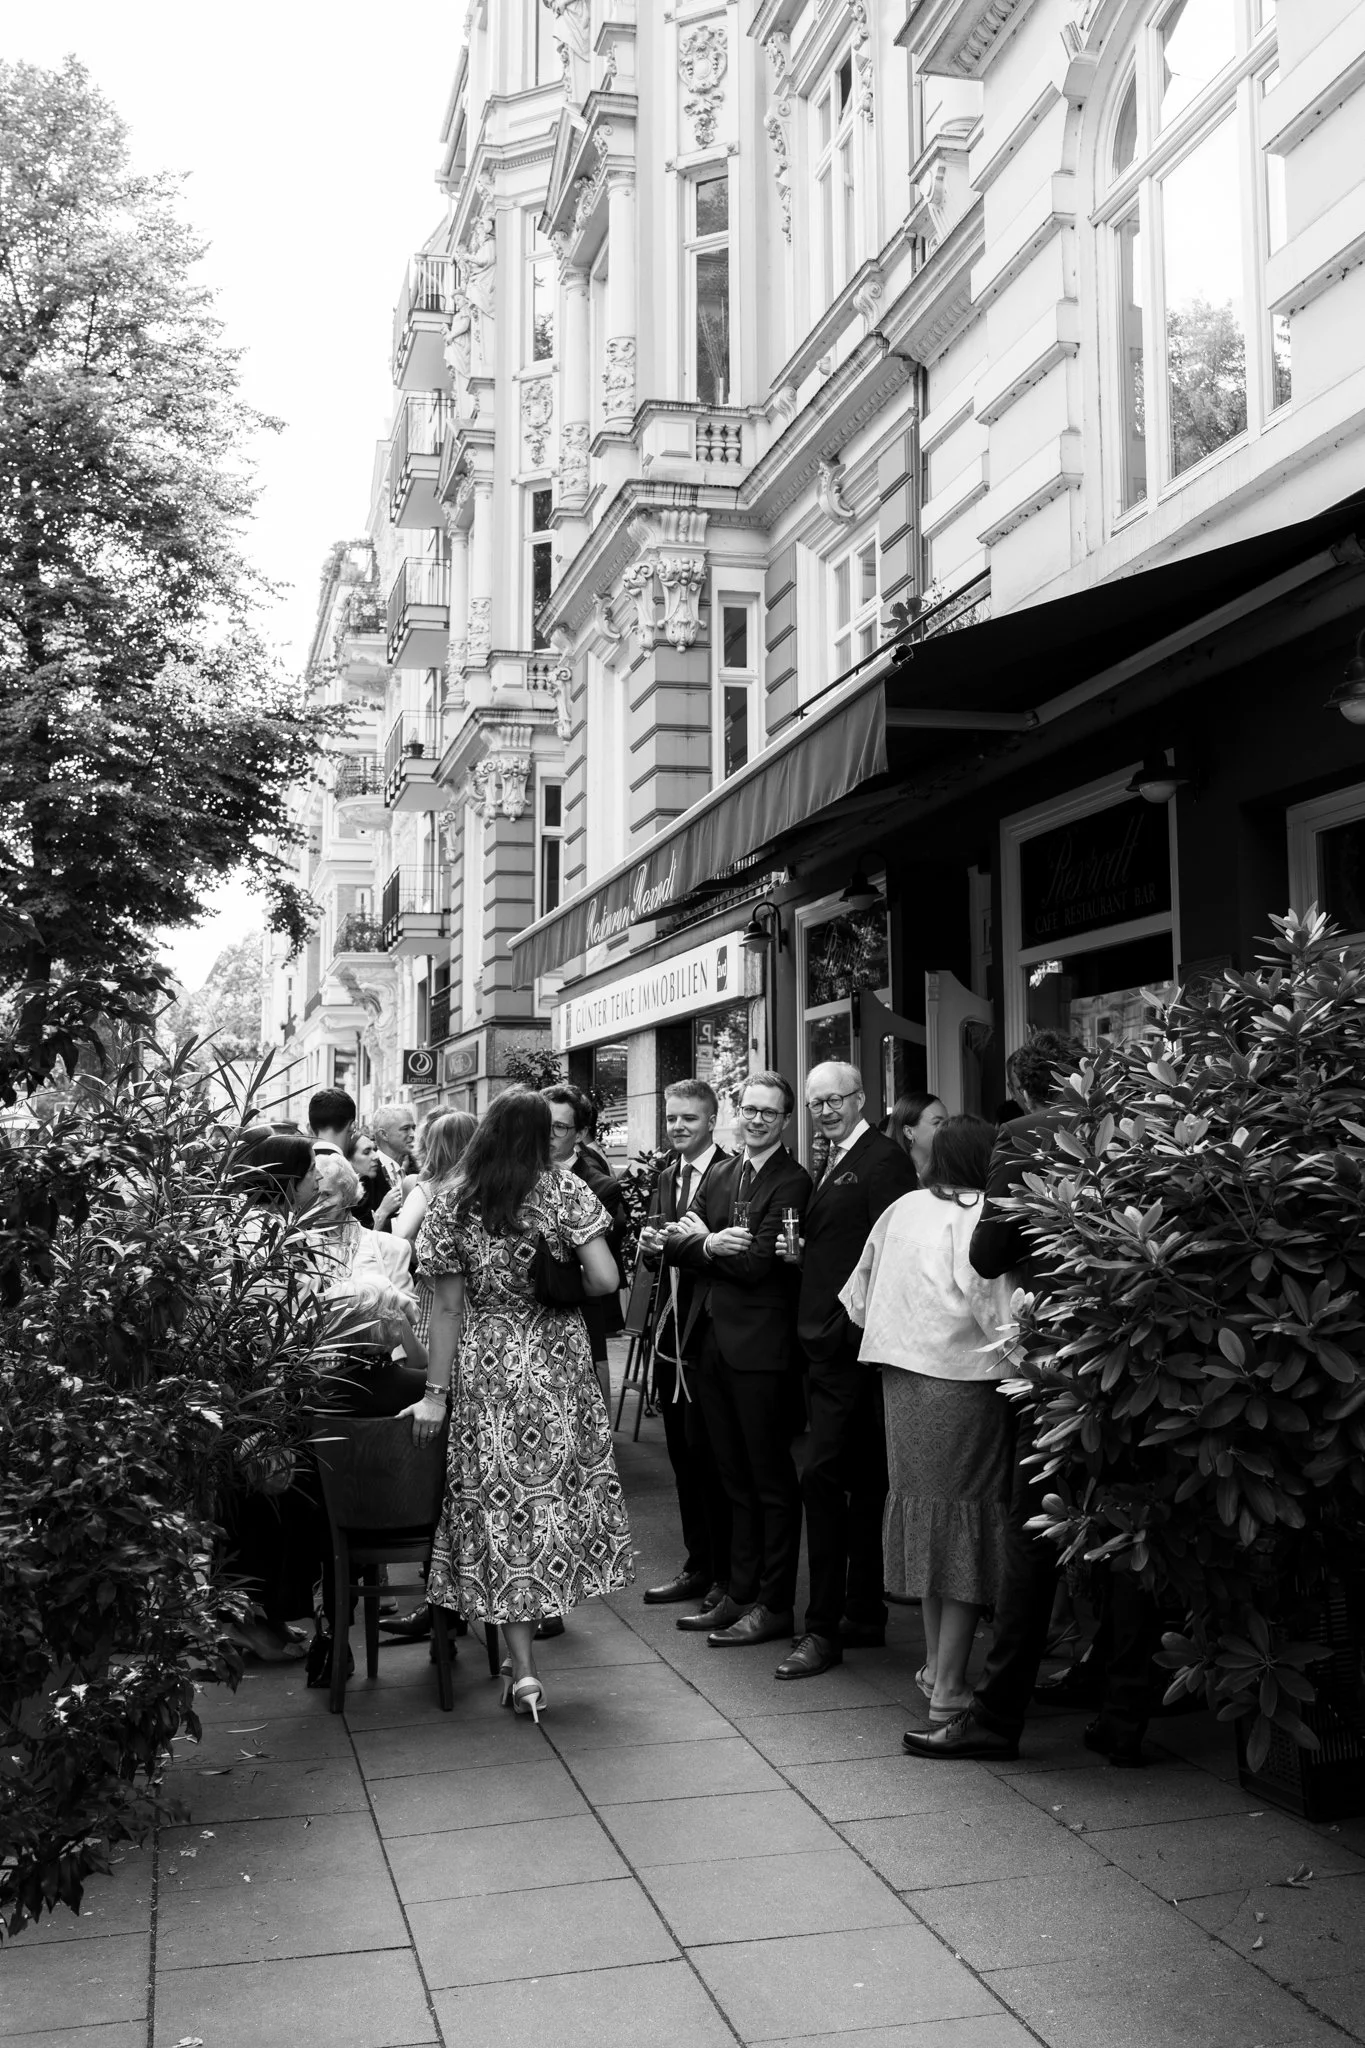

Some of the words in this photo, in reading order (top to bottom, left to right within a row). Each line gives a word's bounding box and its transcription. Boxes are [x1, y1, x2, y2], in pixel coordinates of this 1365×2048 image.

[1064, 889, 1127, 926] RESTAURANT
[1133, 881, 1157, 907] BAR
[575, 999, 607, 1034] GÜNTER
[610, 987, 634, 1022] TEIKE
[638, 958, 708, 1014] IMMOBILIEN
